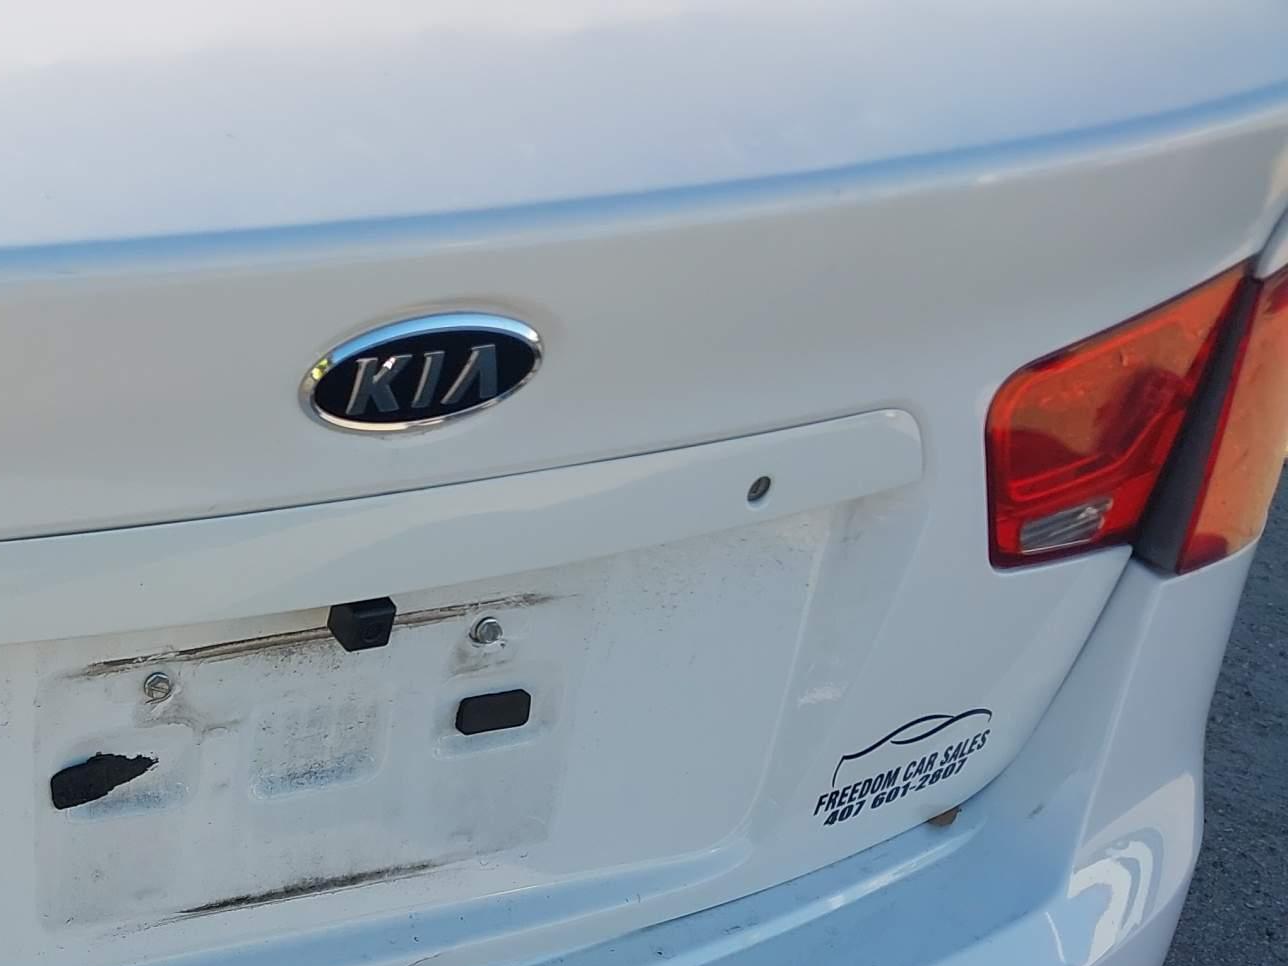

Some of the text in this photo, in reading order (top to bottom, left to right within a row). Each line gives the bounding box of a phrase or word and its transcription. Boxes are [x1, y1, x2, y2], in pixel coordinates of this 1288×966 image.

[345, 344, 499, 415] KIA
[813, 729, 991, 816] FREEDOM CAR SALES
[823, 757, 968, 826] 407 601-2807
